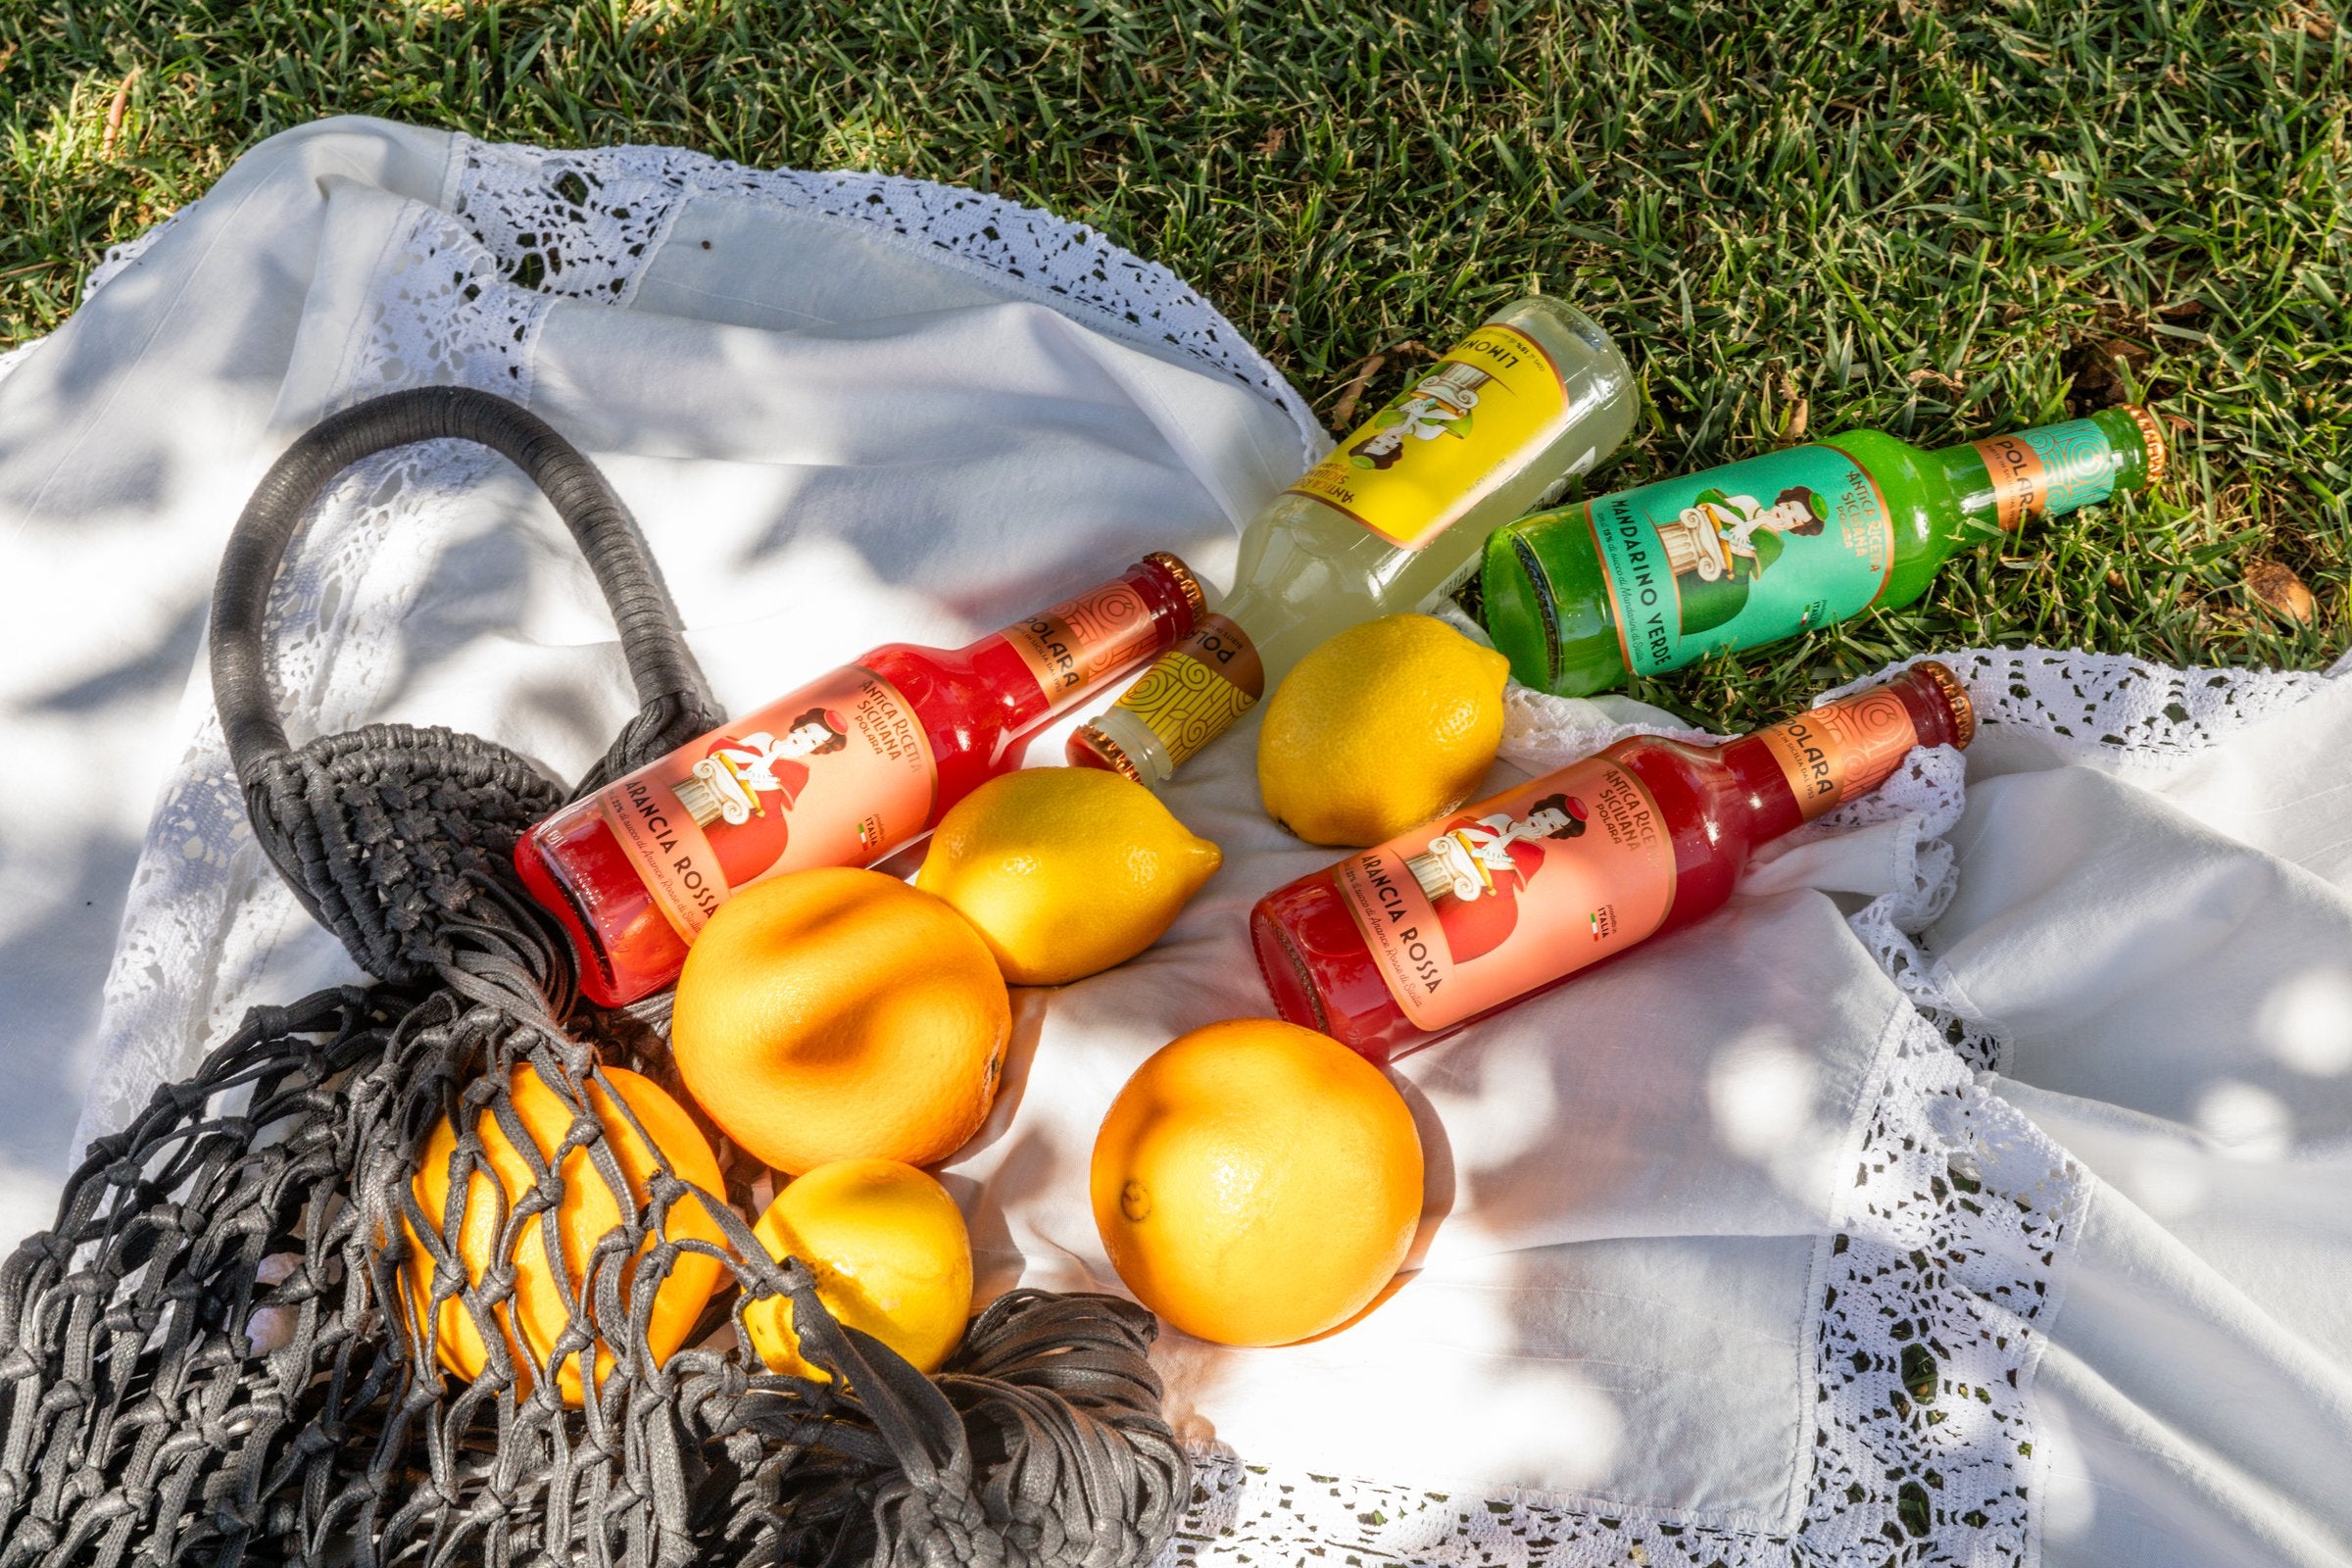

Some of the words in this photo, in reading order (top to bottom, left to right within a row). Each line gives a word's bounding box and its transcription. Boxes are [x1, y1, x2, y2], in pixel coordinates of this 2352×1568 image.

[1312, 480, 1354, 503] ANTICA
[1602, 528, 1611, 543] 15%
[1841, 492, 1868, 558] SICILIANA
[1845, 470, 1876, 517] ANTICA
[1867, 520, 1883, 572] RICETTA
[1611, 551, 1623, 576] succo
[1619, 574, 1628, 586] di
[1612, 500, 1657, 607] MANDARINO
[1646, 612, 1672, 665] VERDE
[1621, 585, 1638, 633] Mandarini
[1020, 617, 1080, 687] POLARA
[1032, 640, 1049, 662] SICILIA
[1631, 632, 1639, 642] di
[855, 715, 883, 755] POLARA
[858, 700, 902, 760] SICILIANA
[859, 679, 898, 719] ANTICA
[893, 718, 923, 773] RICETTA
[1777, 719, 1834, 795] POLARA
[1788, 743, 1804, 767] SICILIA
[1602, 768, 1641, 810] ANTICA
[865, 817, 876, 847] ITALIA
[1595, 804, 1622, 845] POLARA
[1599, 789, 1641, 852] SICILIANA
[612, 799, 624, 813] 22%
[624, 819, 638, 842] succo
[636, 836, 645, 850] di
[641, 846, 663, 880] Arance
[662, 878, 680, 905] Rosse
[677, 902, 686, 912] di
[626, 781, 678, 854] ARANCIA
[673, 857, 720, 918] ROSSA
[1355, 889, 1369, 909] succo
[1365, 906, 1377, 918] di
[1362, 856, 1407, 923] ARANCIA
[1399, 927, 1443, 994] ROSSA
[1370, 915, 1390, 949] Arance
[1597, 907, 1610, 939] ITALIA
[1386, 948, 1402, 974] Rosse
[1399, 971, 1407, 984] di
[1403, 983, 1423, 1007] Sicilia
